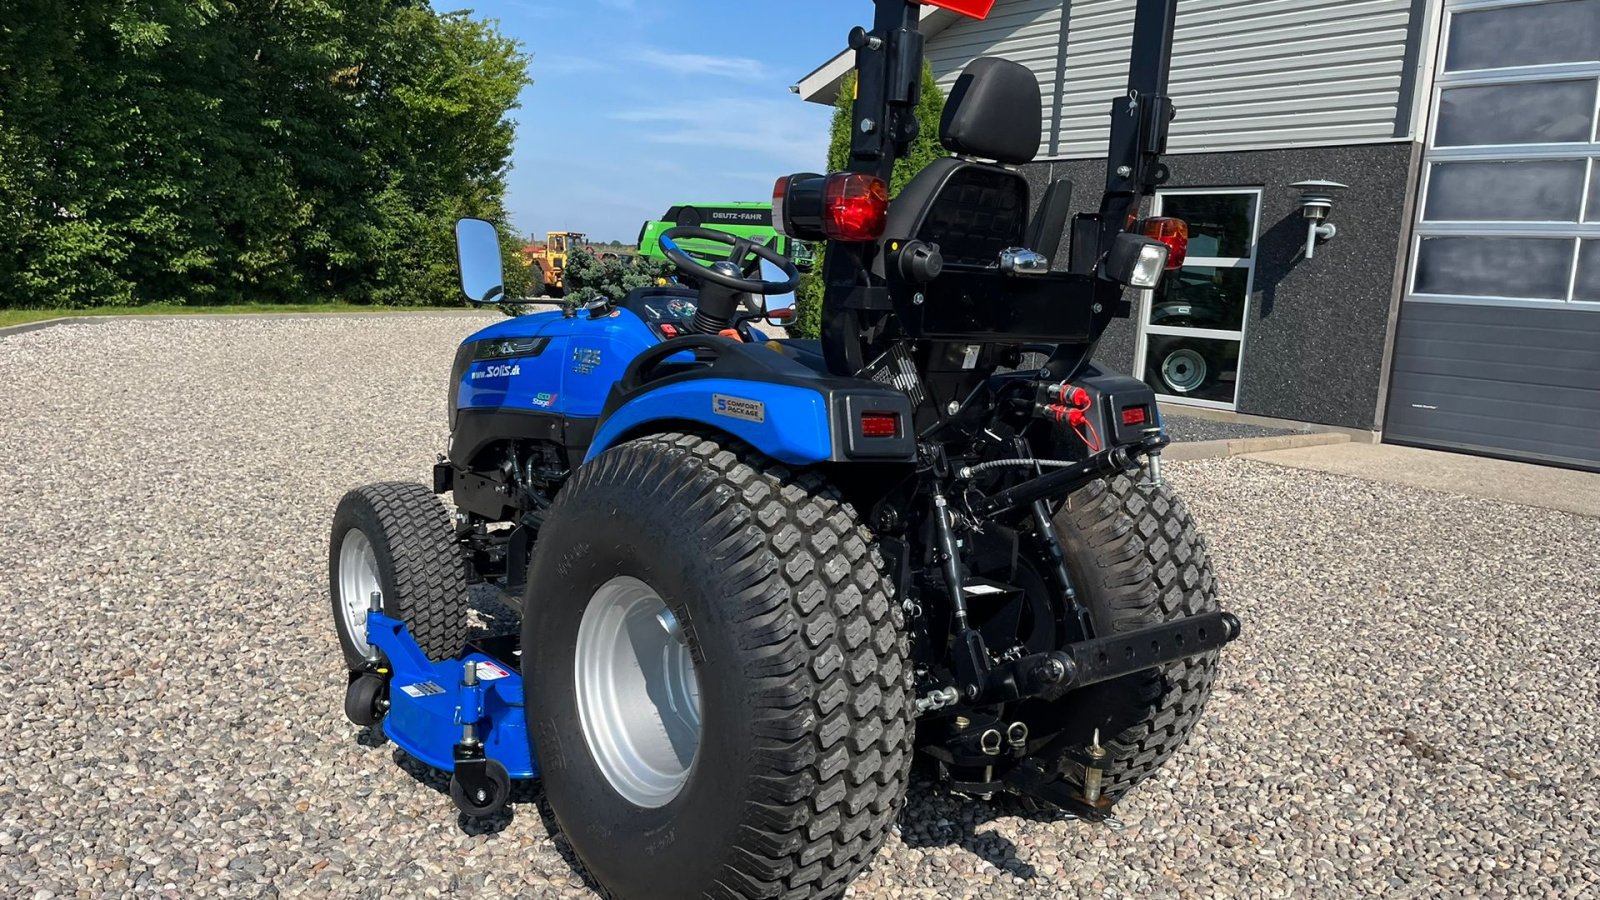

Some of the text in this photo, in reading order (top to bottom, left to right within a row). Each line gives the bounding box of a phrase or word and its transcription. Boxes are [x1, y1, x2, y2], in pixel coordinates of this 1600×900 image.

[712, 212, 762, 220] DEUTZ-FAHR
[727, 400, 758, 410] COMFORT
[728, 406, 758, 416] PACKAGE
